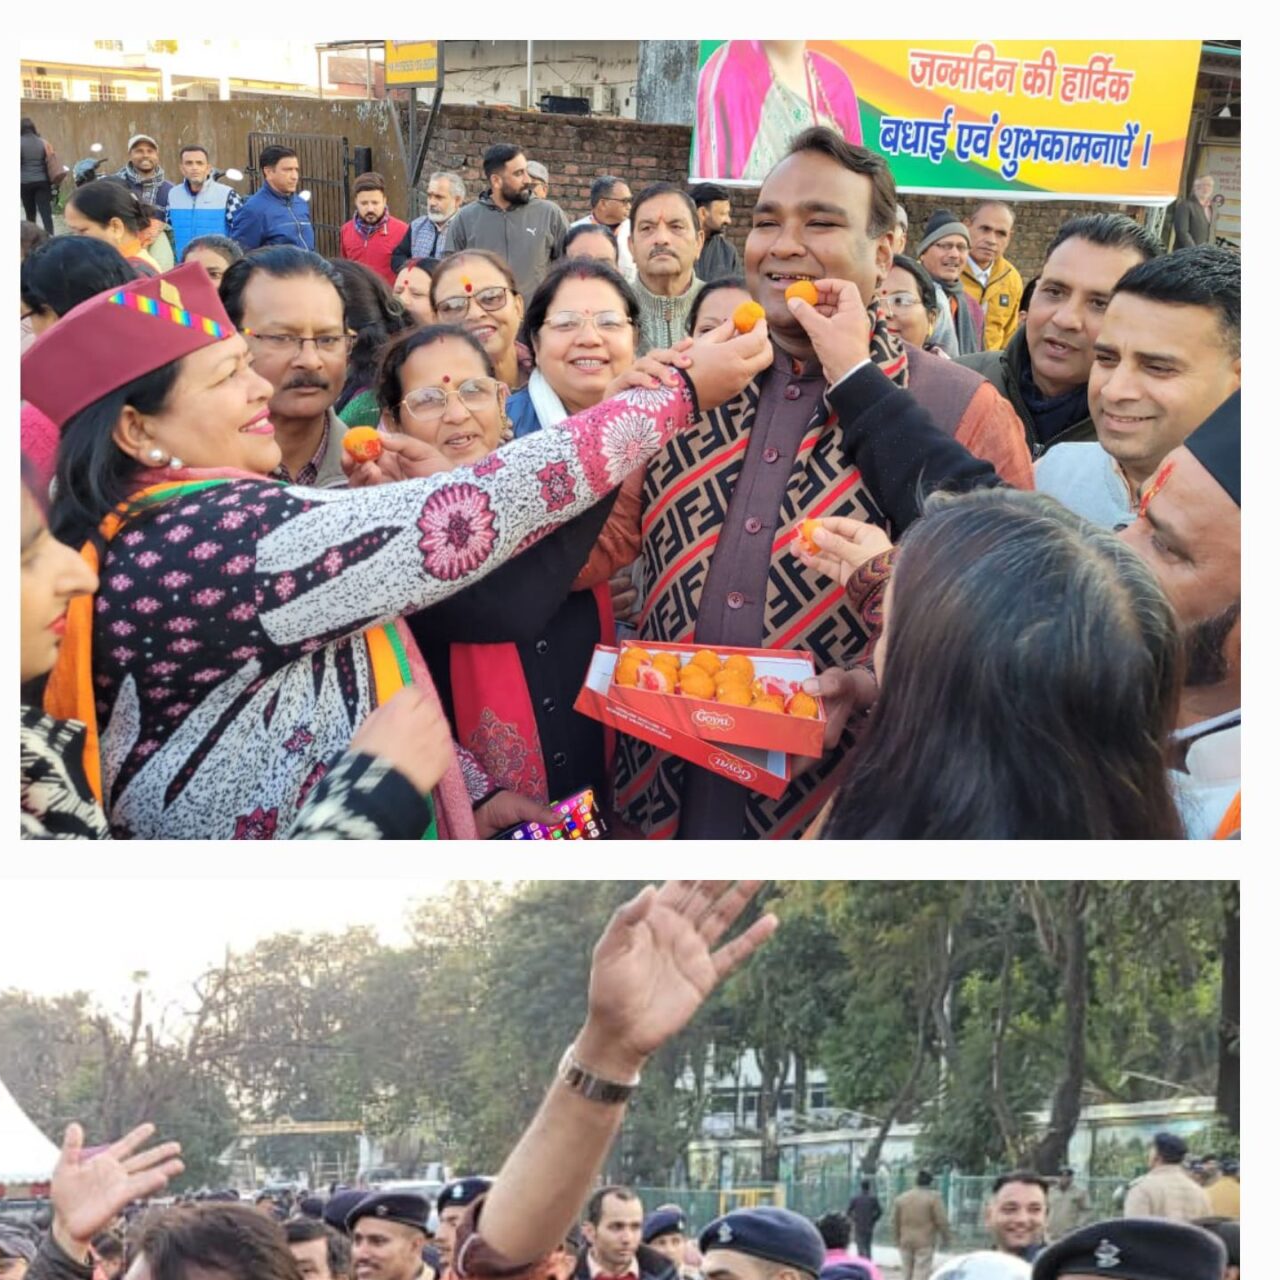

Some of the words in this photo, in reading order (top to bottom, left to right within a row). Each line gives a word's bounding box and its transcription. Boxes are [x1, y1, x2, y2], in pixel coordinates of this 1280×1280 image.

[909, 43, 1018, 94] जन्मदिन
[1023, 50, 1057, 97] की
[1061, 55, 1134, 102] हार्दिक
[880, 108, 953, 161] बधाई
[956, 114, 999, 160] एवं
